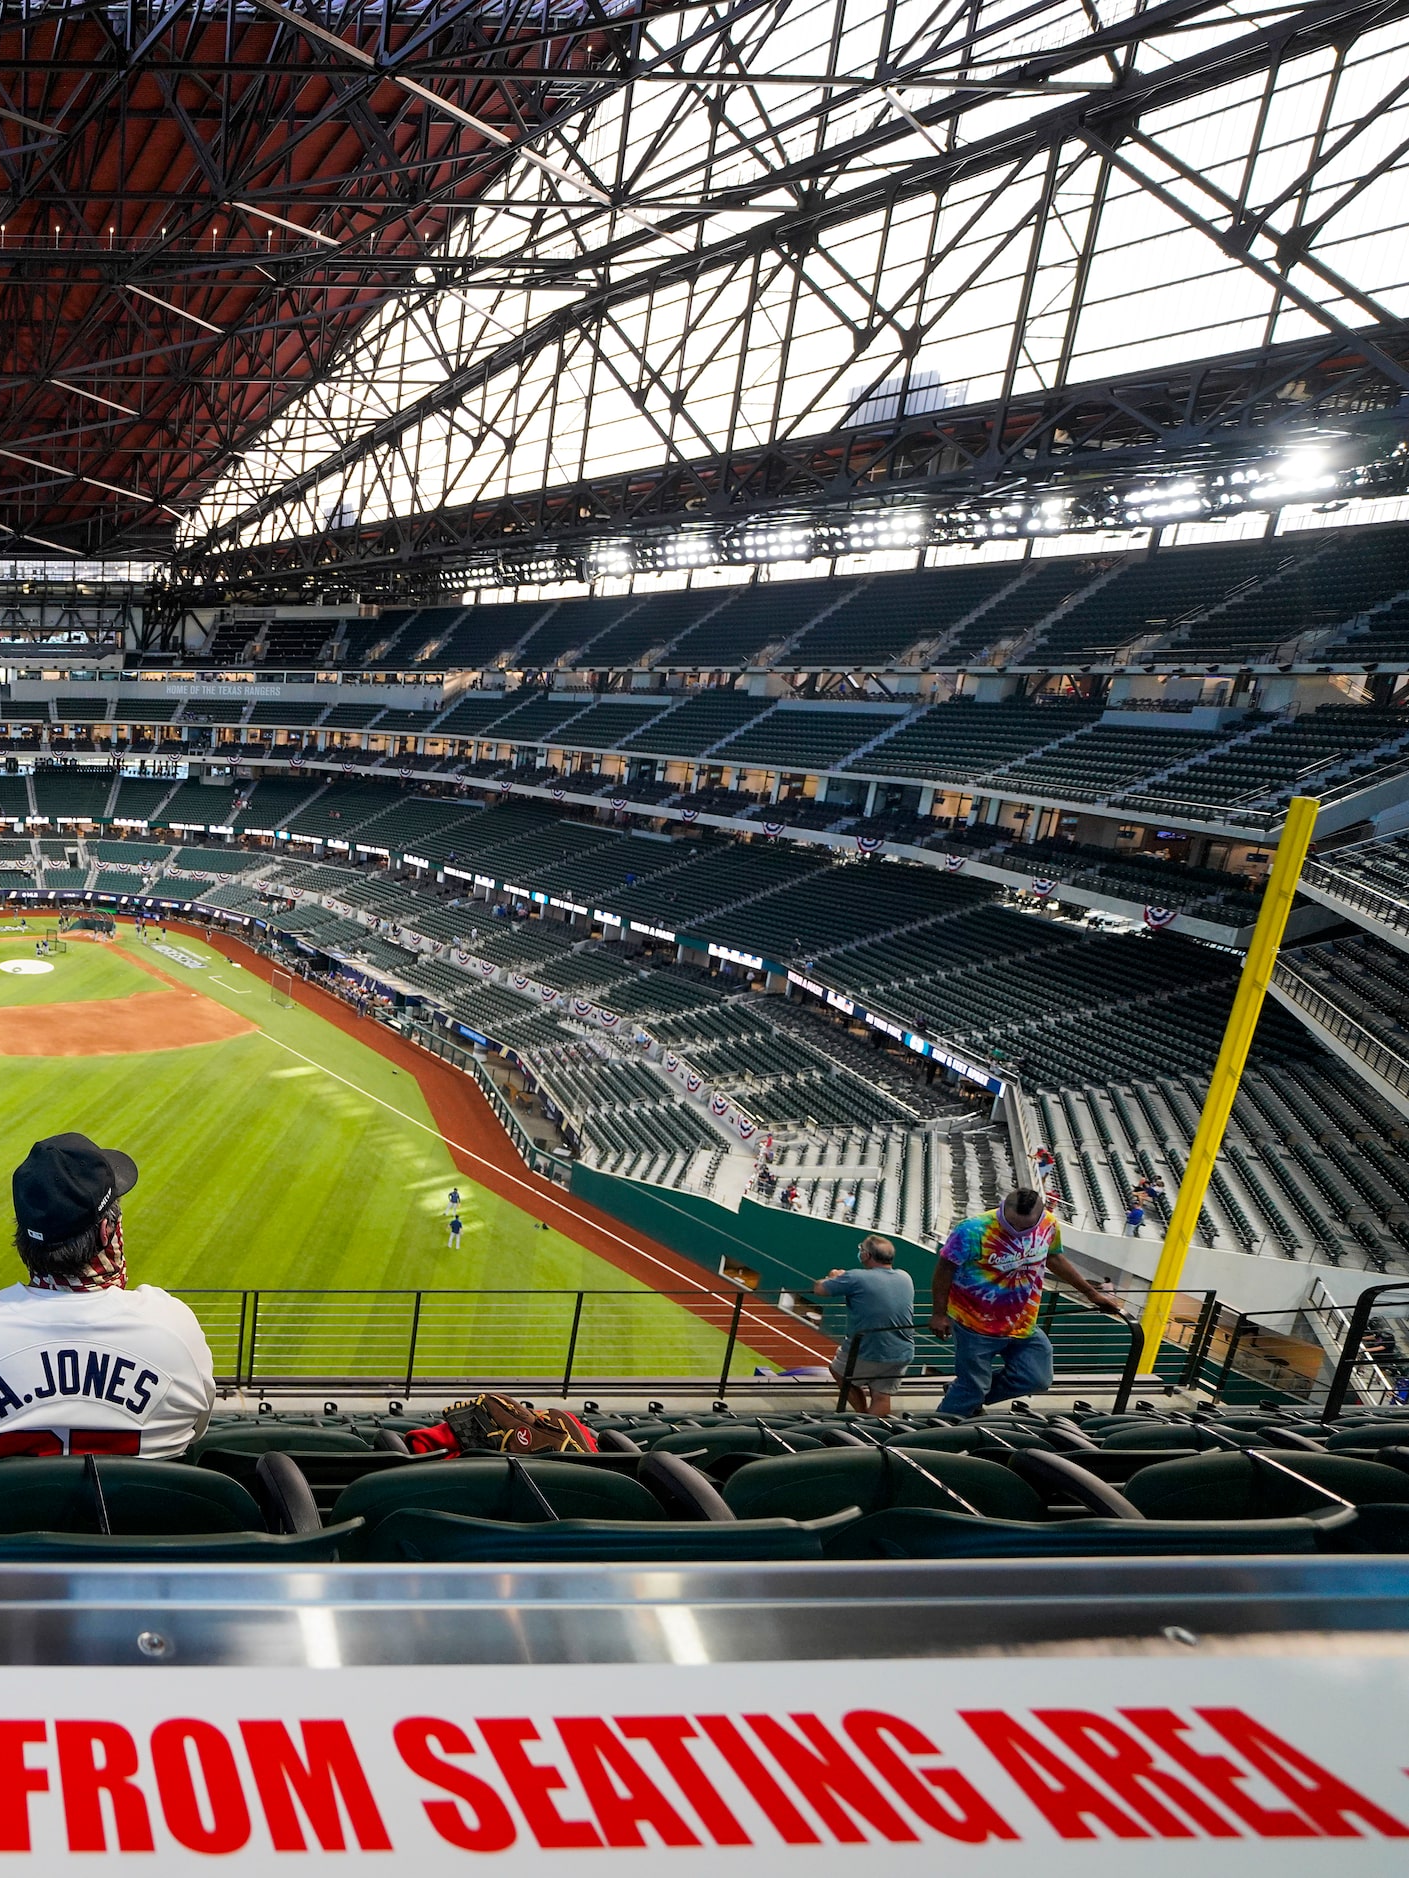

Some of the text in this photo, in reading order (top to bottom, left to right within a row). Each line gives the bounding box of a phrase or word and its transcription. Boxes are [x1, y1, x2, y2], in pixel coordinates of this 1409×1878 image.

[166, 685, 281, 696] HOME OF THE TEXAS RANGERS
[392, 1709, 1022, 1853] SEATING
[957, 1707, 1409, 1840] AREA
